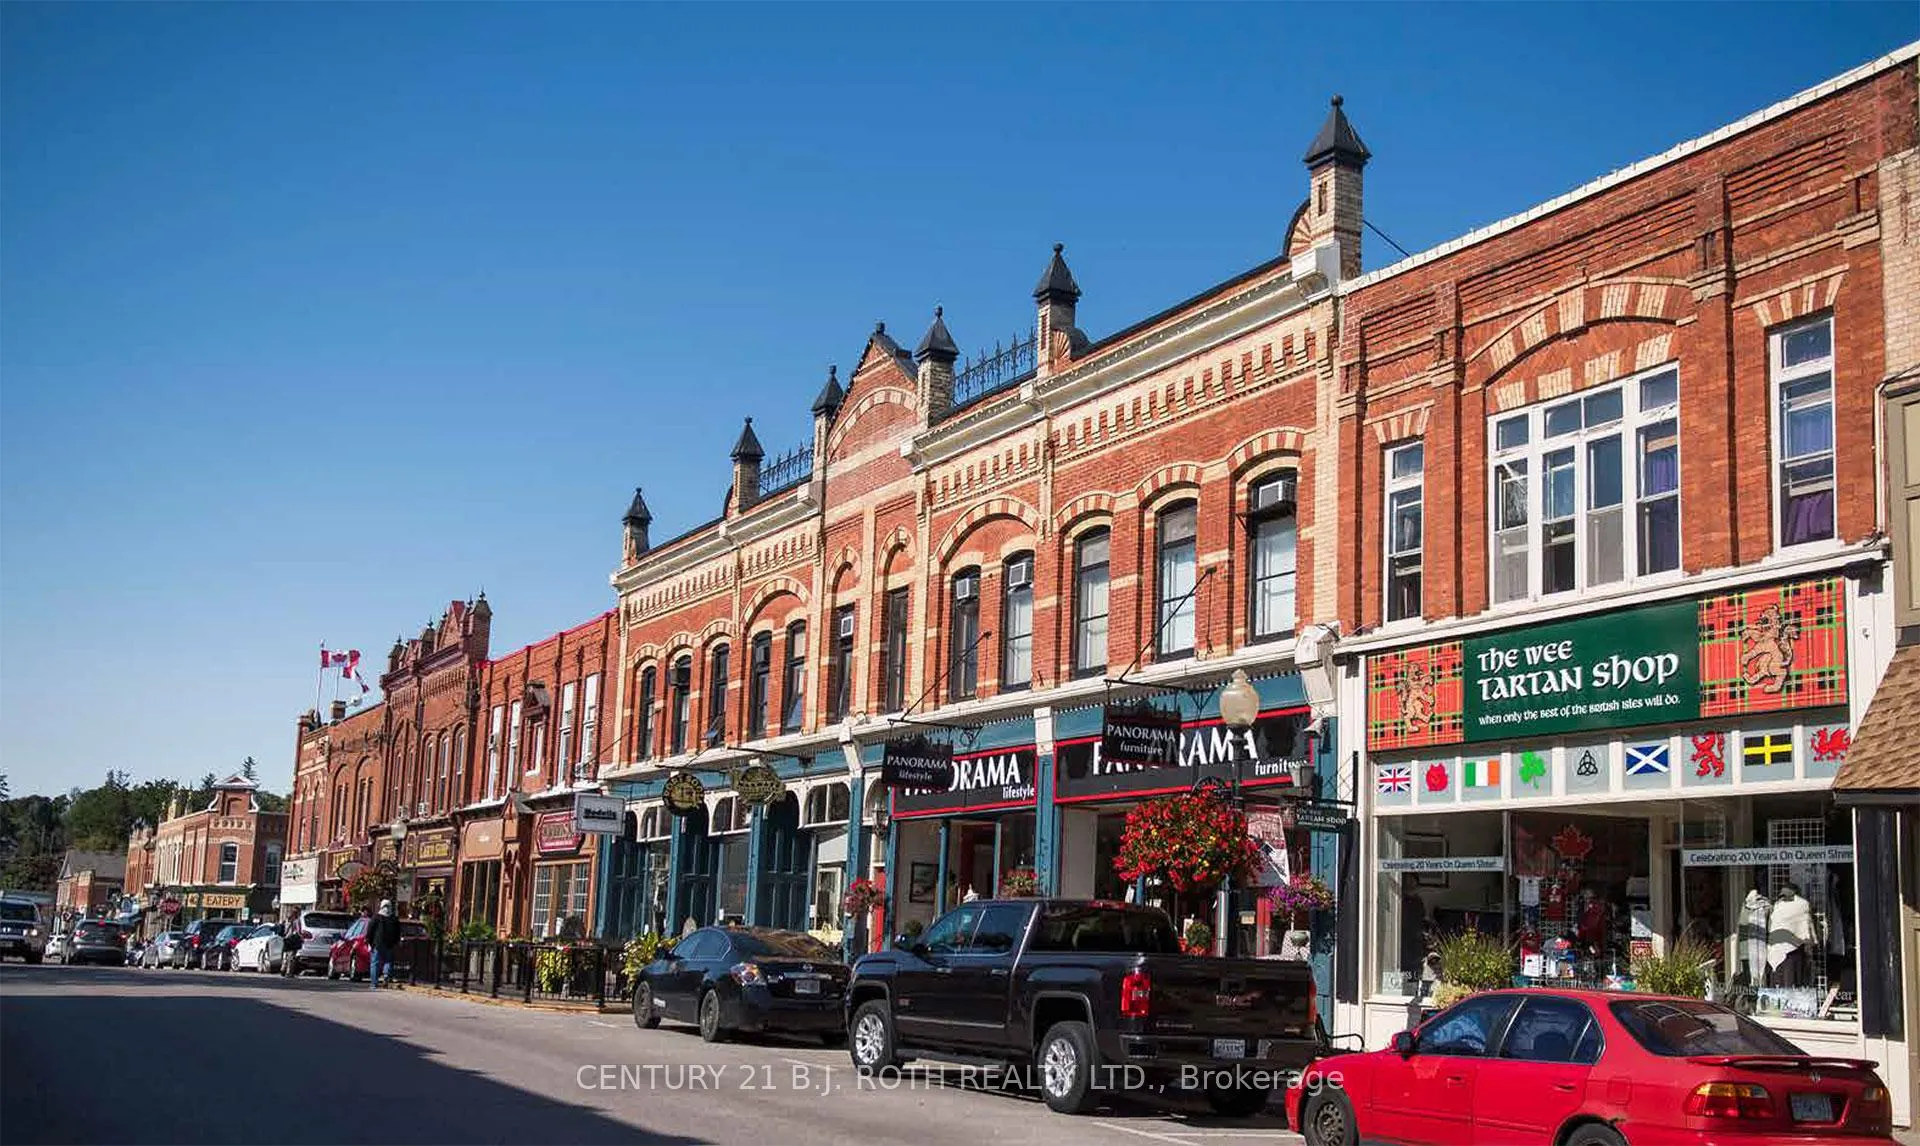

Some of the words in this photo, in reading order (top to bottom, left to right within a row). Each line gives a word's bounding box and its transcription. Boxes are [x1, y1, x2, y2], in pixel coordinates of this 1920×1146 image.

[1477, 666, 1583, 701] TARTAN
[1503, 712, 1523, 724] only
[1524, 709, 1540, 721] the
[1560, 706, 1572, 718] of
[1572, 704, 1588, 715] the
[1644, 695, 1663, 707] will
[1107, 723, 1177, 742] PANORAMA
[1119, 741, 1164, 756] furniture
[887, 755, 948, 771] PANORAMA
[1002, 783, 1035, 801] lifestyle
[1690, 853, 1737, 864] Celebrating
[1738, 852, 1750, 861] 20
[1752, 852, 1777, 861] Years
[1779, 851, 1794, 861] On
[1795, 850, 1826, 861] Queen
[206, 894, 241, 907] EATERY
